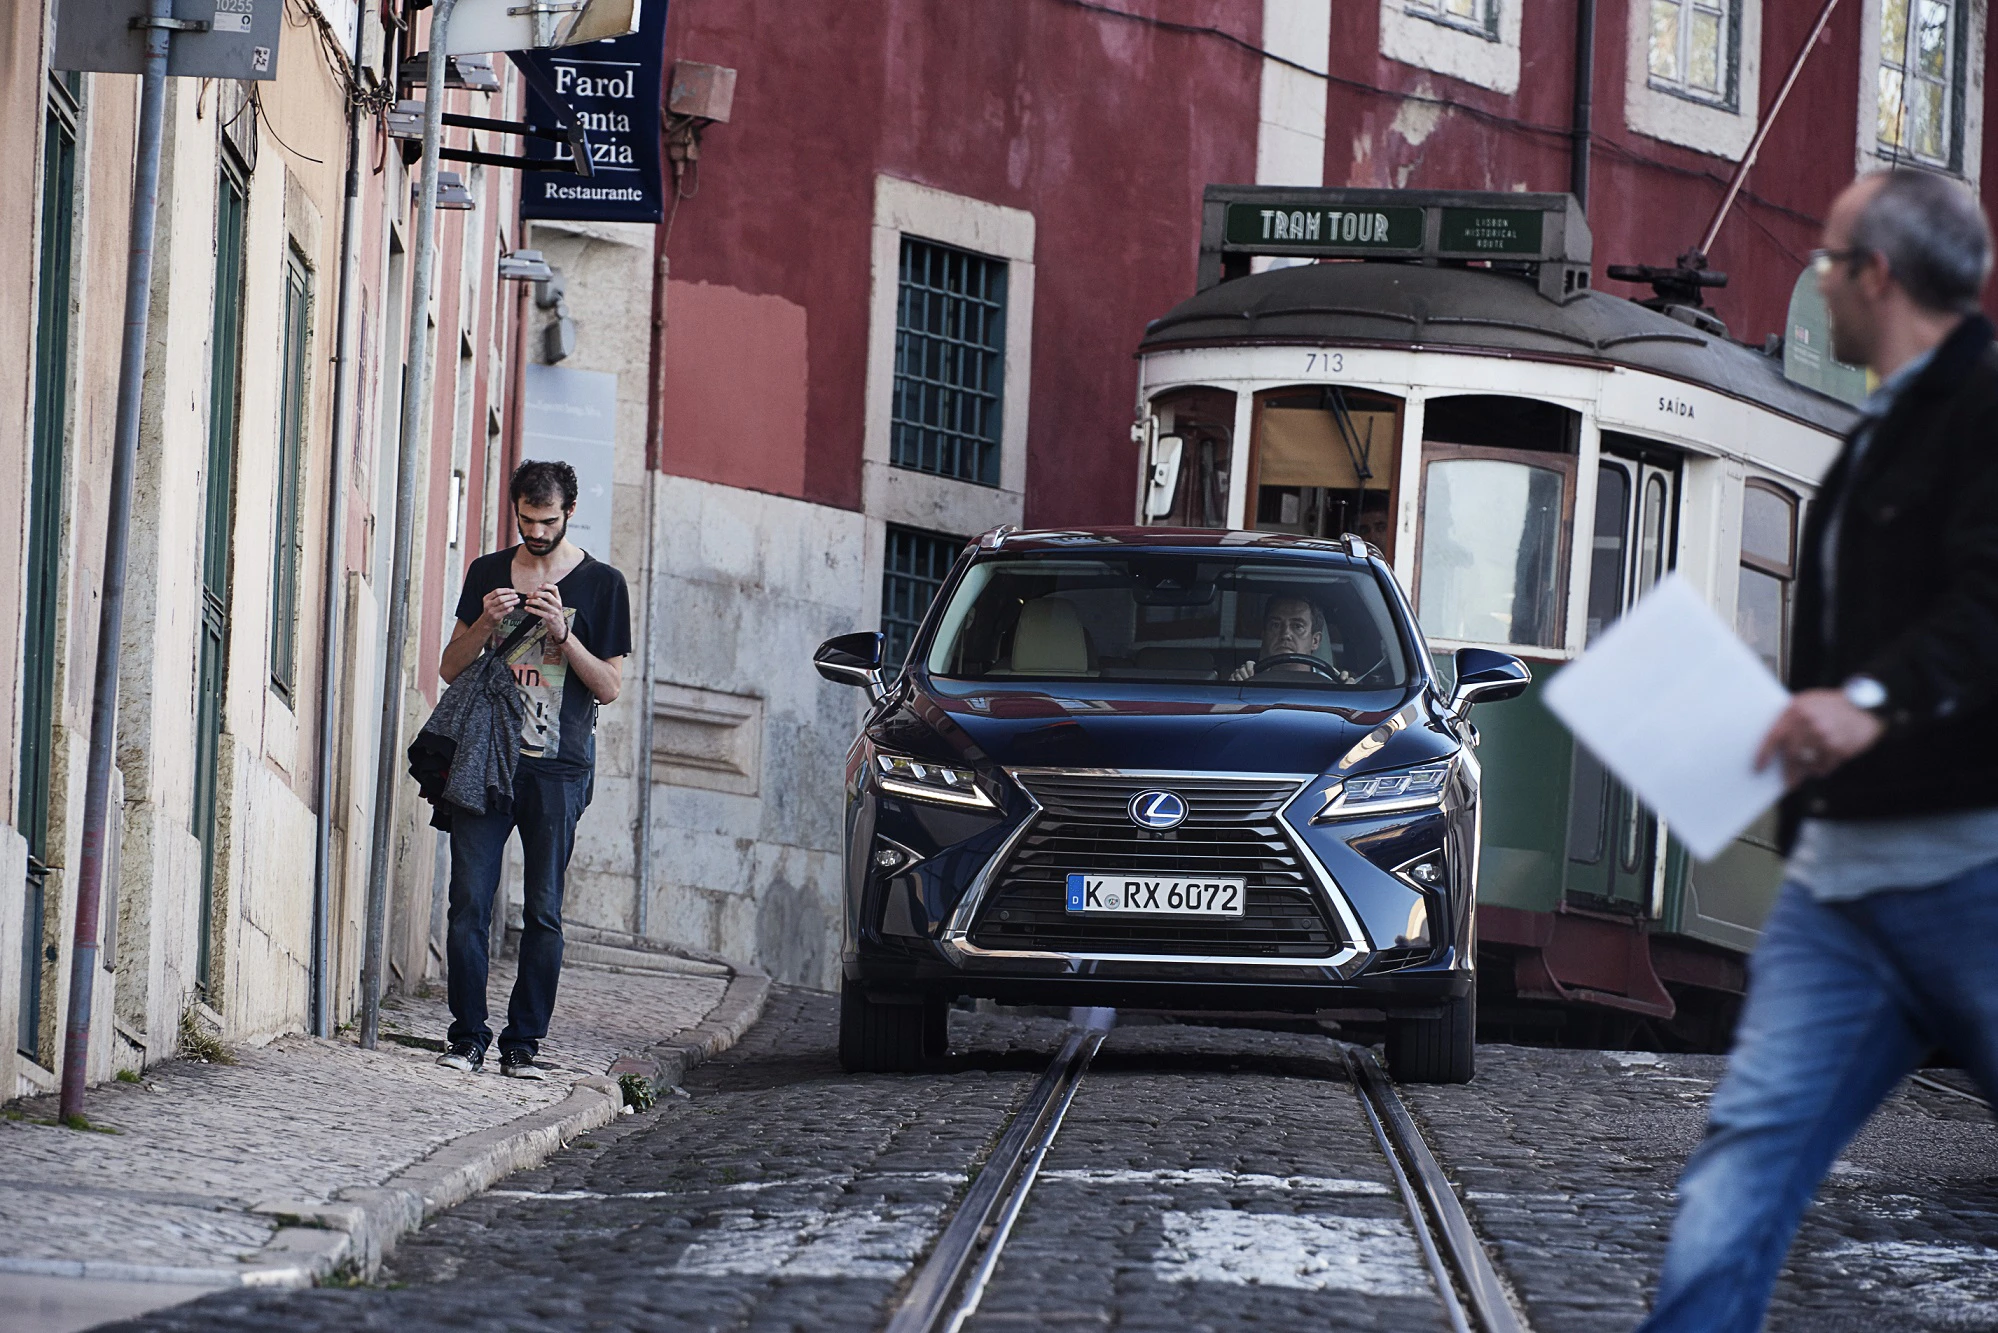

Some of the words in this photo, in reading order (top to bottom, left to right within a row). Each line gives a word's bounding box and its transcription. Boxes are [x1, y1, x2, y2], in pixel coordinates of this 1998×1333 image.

[554, 66, 635, 98] Farol
[556, 104, 631, 132] anta
[554, 137, 634, 163] Lzia
[544, 182, 643, 201] Restaurante
[1260, 210, 1321, 240] TRAM
[1328, 211, 1389, 242] TOUR
[1306, 353, 1344, 373] 713
[1659, 396, 1695, 419] SAÍDA
[1072, 896, 1079, 905] D
[1085, 881, 1104, 908] K
[1124, 882, 1160, 909] RX
[1167, 883, 1238, 911] 6072
